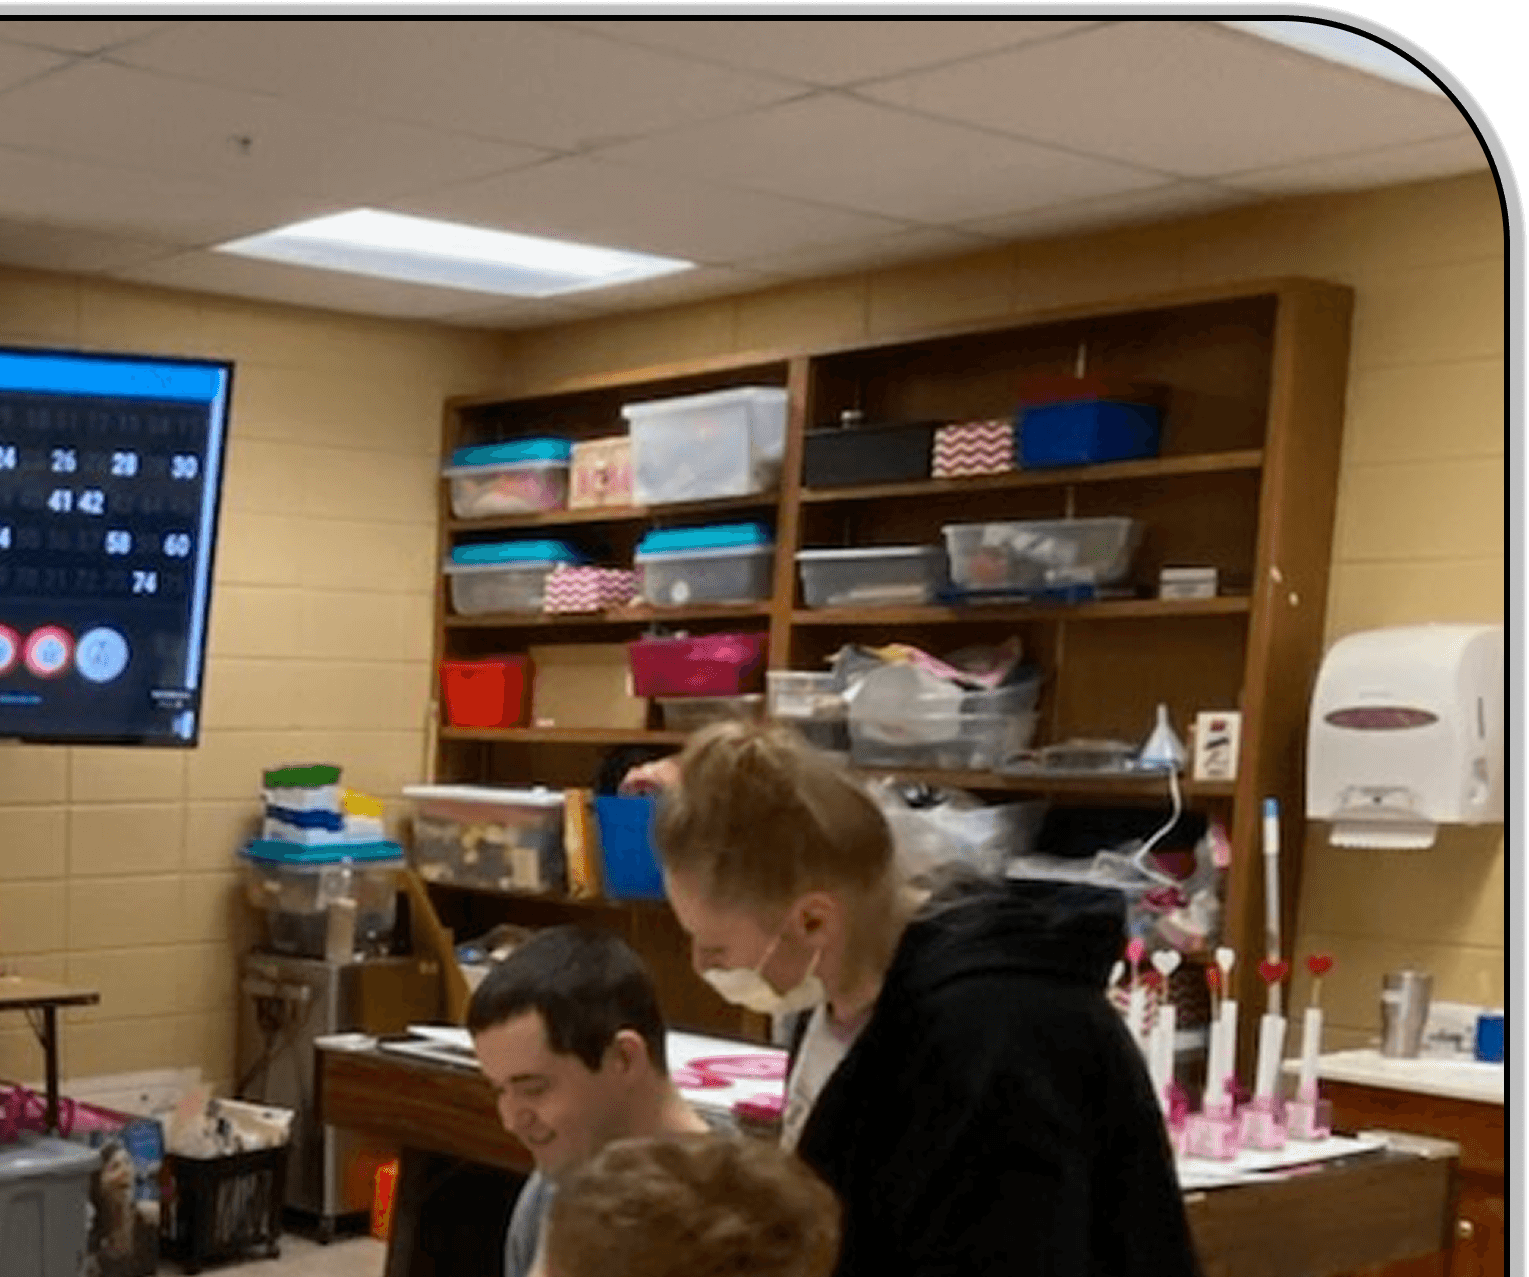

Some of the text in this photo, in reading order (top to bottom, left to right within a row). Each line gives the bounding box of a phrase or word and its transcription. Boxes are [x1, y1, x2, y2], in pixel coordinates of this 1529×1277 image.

[172, 454, 198, 479] 30
[47, 488, 72, 512] 41
[77, 490, 105, 514] 42
[132, 570, 158, 594] 74
